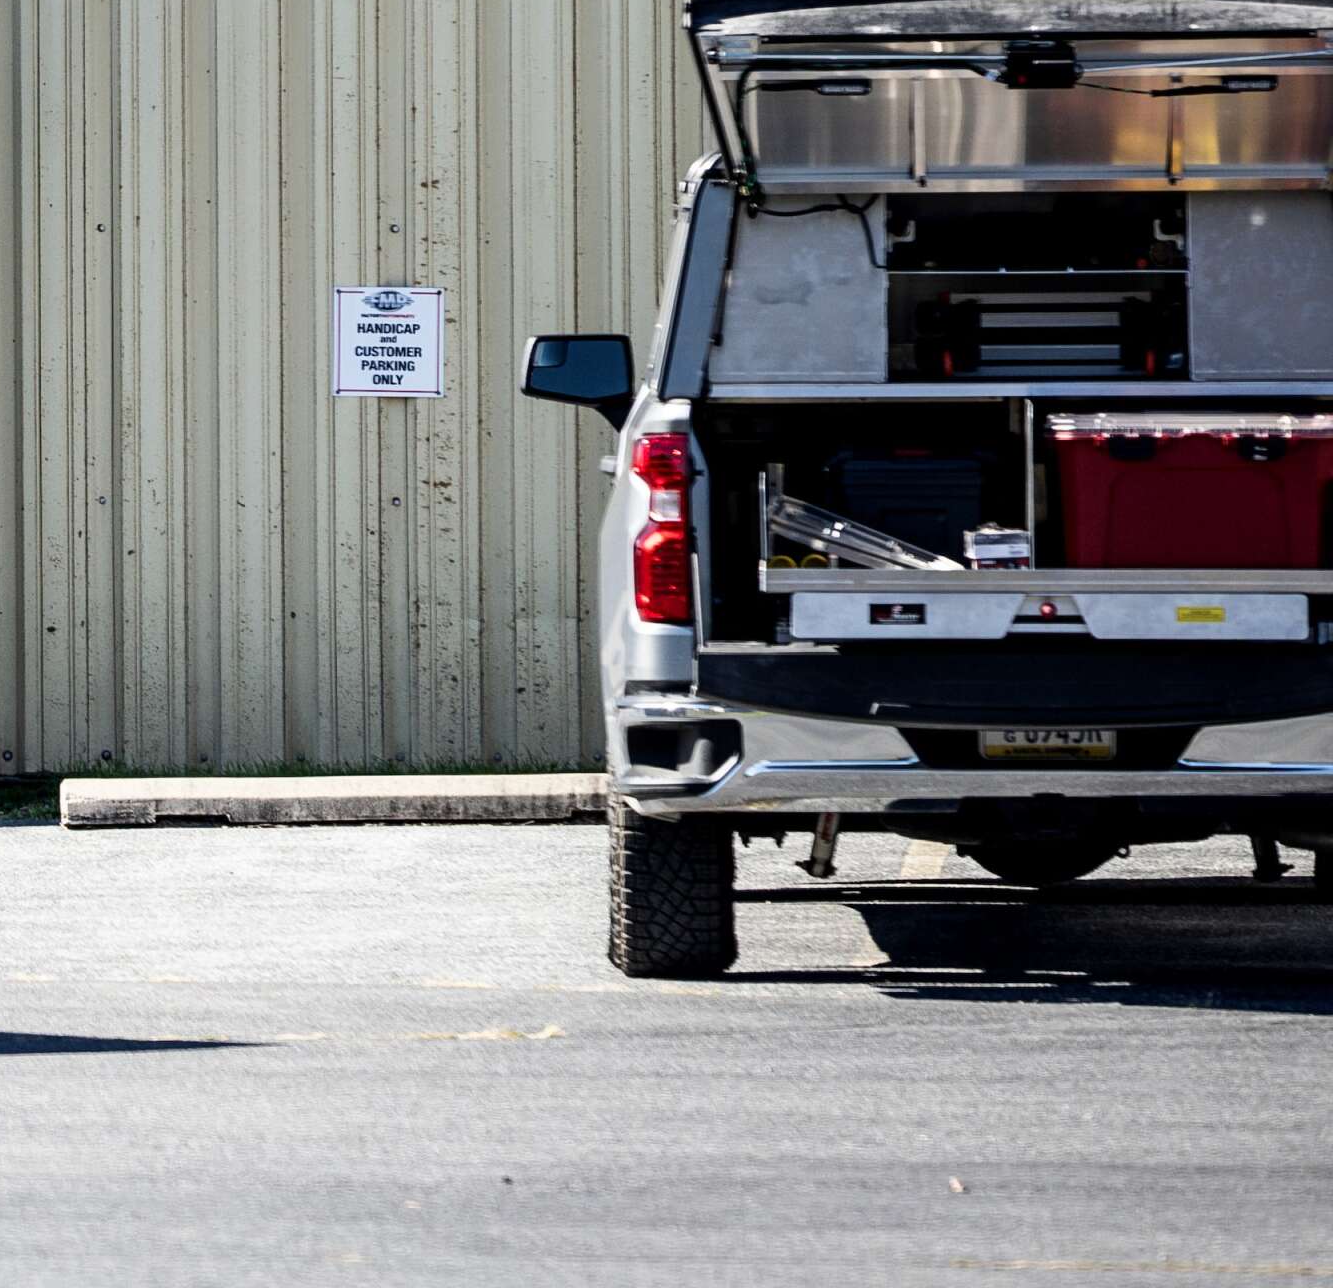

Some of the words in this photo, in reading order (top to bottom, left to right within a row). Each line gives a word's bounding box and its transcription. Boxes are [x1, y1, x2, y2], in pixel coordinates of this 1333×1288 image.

[357, 323, 420, 334] HANDICAP
[355, 346, 422, 357] CUSTOMER
[361, 360, 415, 371] PARKING
[372, 374, 404, 385] ONLY
